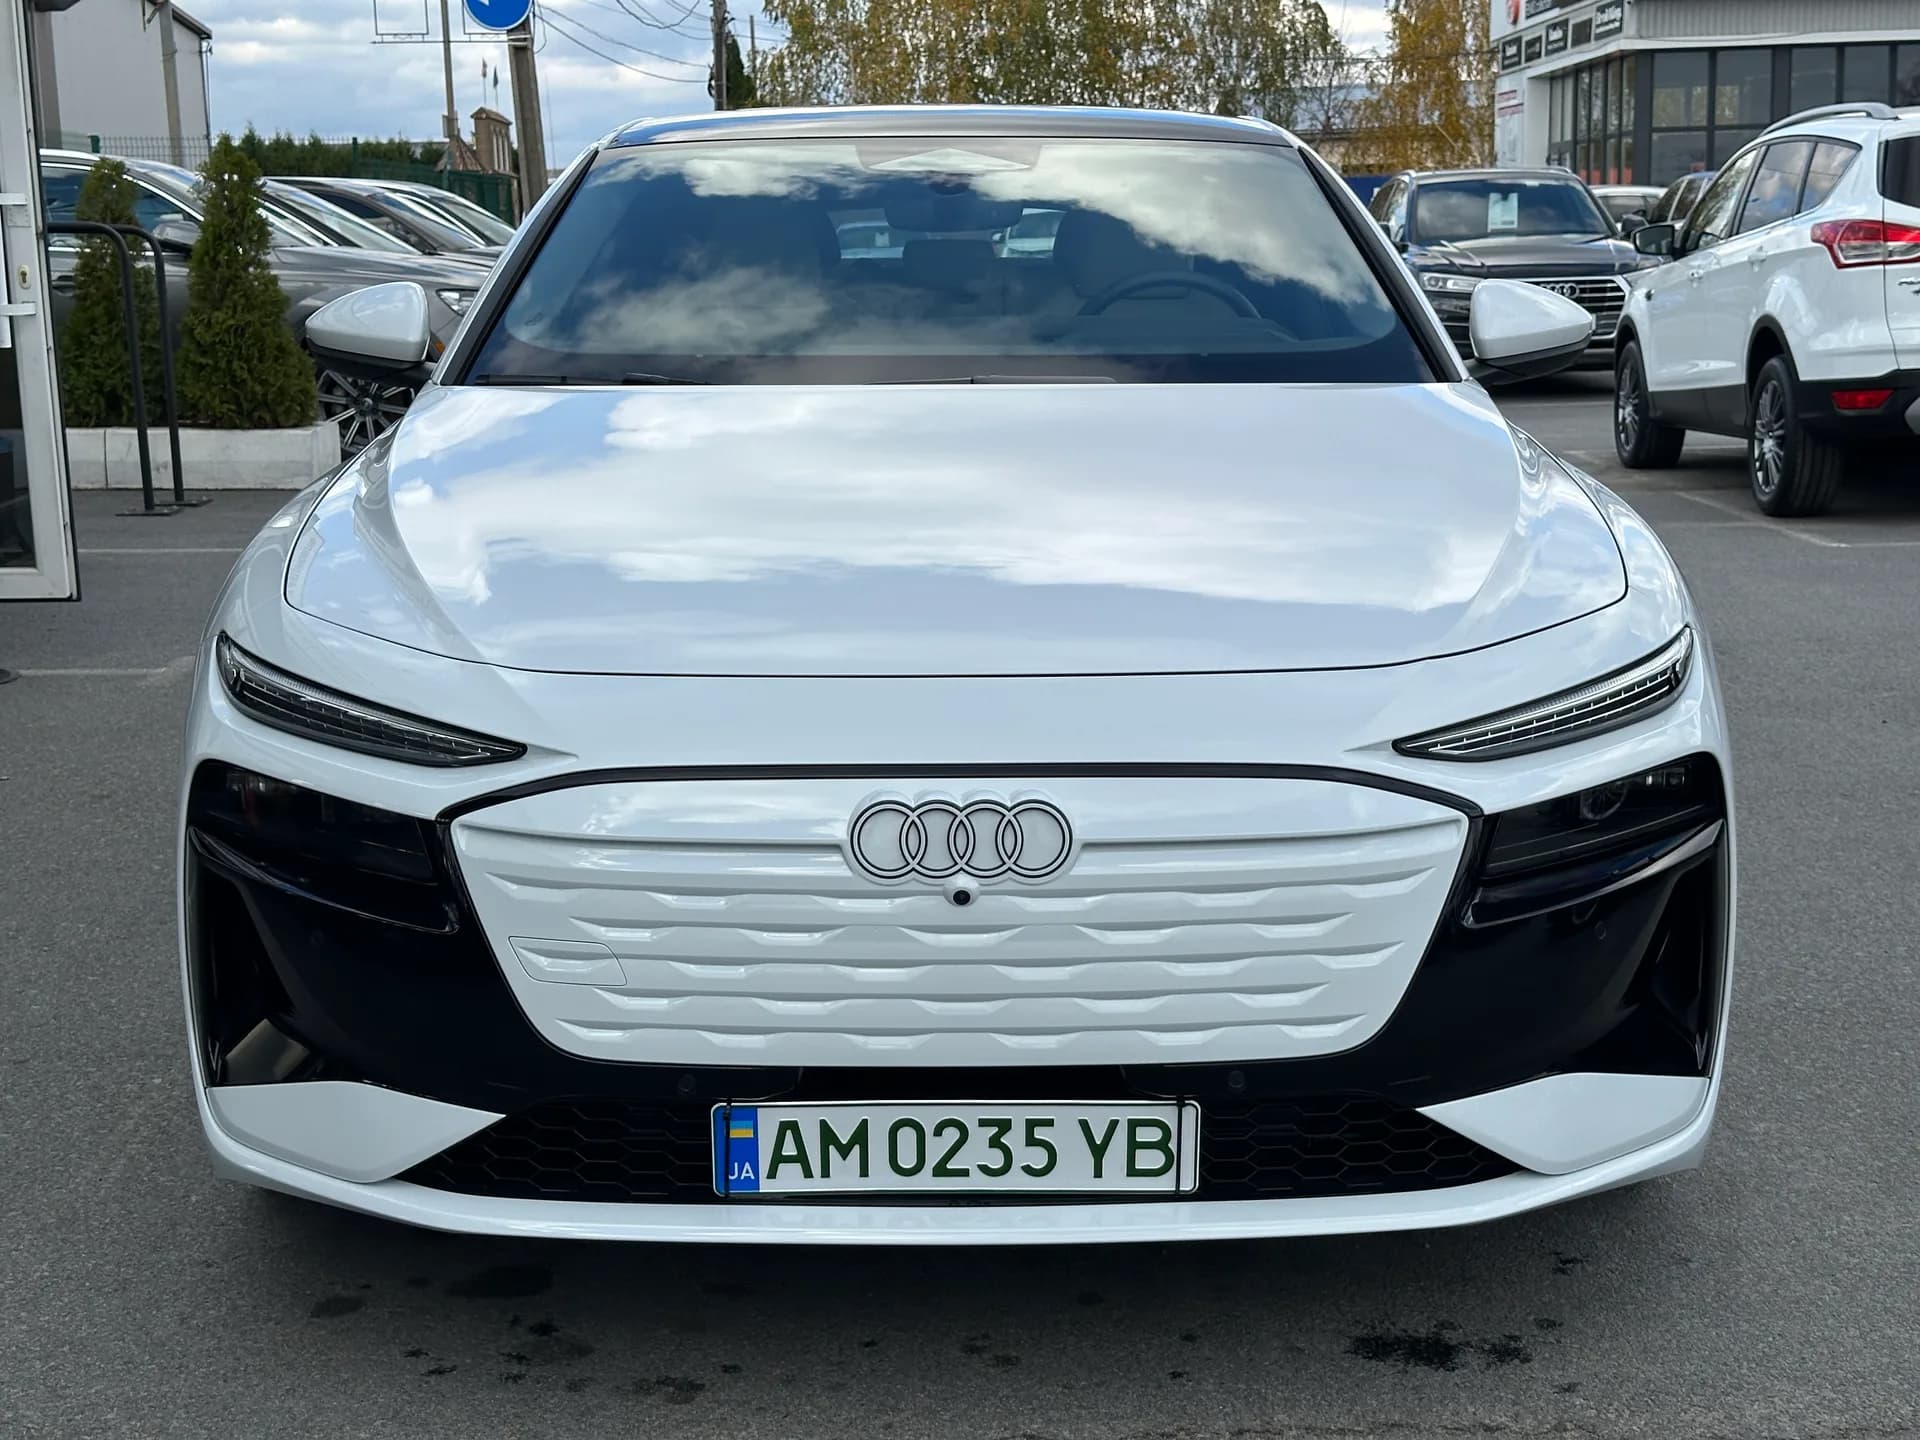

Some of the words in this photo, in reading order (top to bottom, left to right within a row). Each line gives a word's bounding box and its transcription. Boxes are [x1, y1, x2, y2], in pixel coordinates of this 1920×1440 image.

[766, 1118, 870, 1180] AM
[887, 1117, 1058, 1178] 0235
[1077, 1117, 1176, 1179] YB
